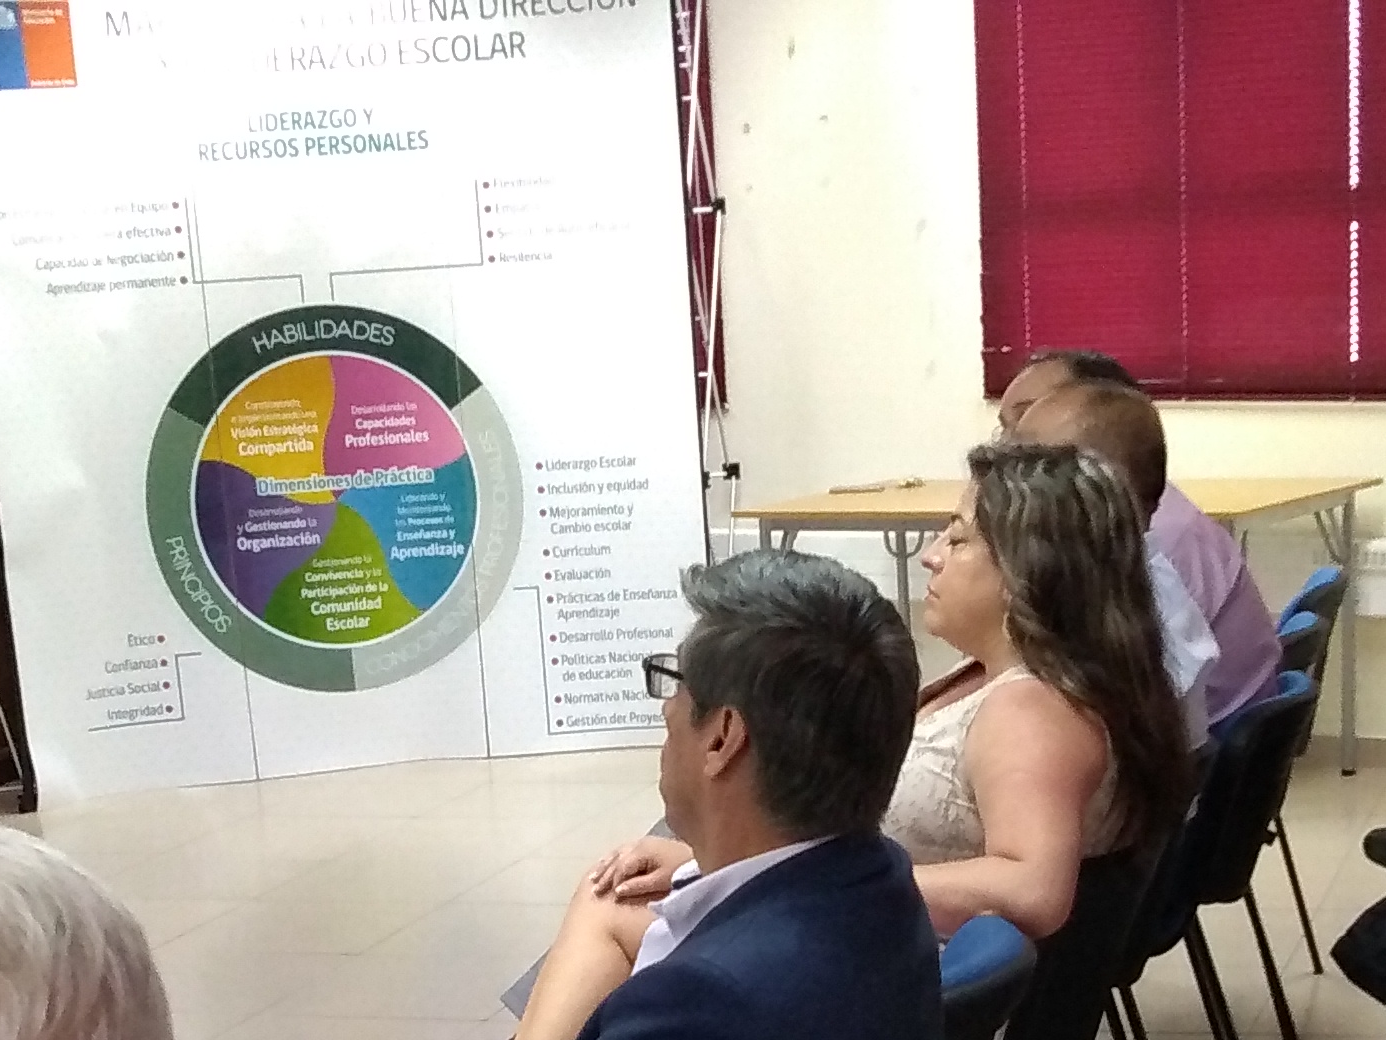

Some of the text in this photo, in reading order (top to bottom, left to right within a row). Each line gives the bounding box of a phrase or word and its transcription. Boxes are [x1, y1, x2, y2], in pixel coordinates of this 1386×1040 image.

[479, 0, 637, 20] DIRECC
[399, 31, 527, 66] ESCOLAR
[248, 108, 373, 132] LIDERAZGO Y
[199, 130, 429, 161] RECURSOS PERSONALES
[251, 319, 395, 354] HABILIDADES
[355, 415, 416, 430] Capacidades
[344, 428, 430, 449] Profesionales
[238, 438, 314, 457] Compartida
[545, 455, 636, 472] Liderazgo Escolar
[257, 467, 434, 495] Dimensiones de Práctica
[547, 478, 649, 495] Inclusión y equidad
[549, 502, 634, 519] Mejoramiento y
[244, 517, 307, 533] Gestionando
[550, 519, 632, 535] Cambio escolar
[236, 531, 321, 553] Organización
[390, 541, 465, 562] Aprendizaje
[305, 568, 364, 583] Convivencia
[554, 567, 612, 581] Evaluación
[166, 536, 232, 633] PRINCIPIOS
[301, 582, 364, 599] Participación
[365, 582, 378, 593] de
[556, 588, 678, 604] Prácticas de Enseñanza
[311, 596, 383, 616] Comunidad
[557, 607, 620, 622] Aprendizaje
[326, 615, 371, 632] Escolar
[559, 626, 673, 644] Desarrollo Profesional
[104, 657, 158, 674] Confianza
[563, 667, 633, 682] de educación
[86, 681, 161, 701] Justicia Social
[564, 691, 620, 704] Normativa
[107, 704, 163, 720] Integridad
[566, 713, 607, 727] Gestión
